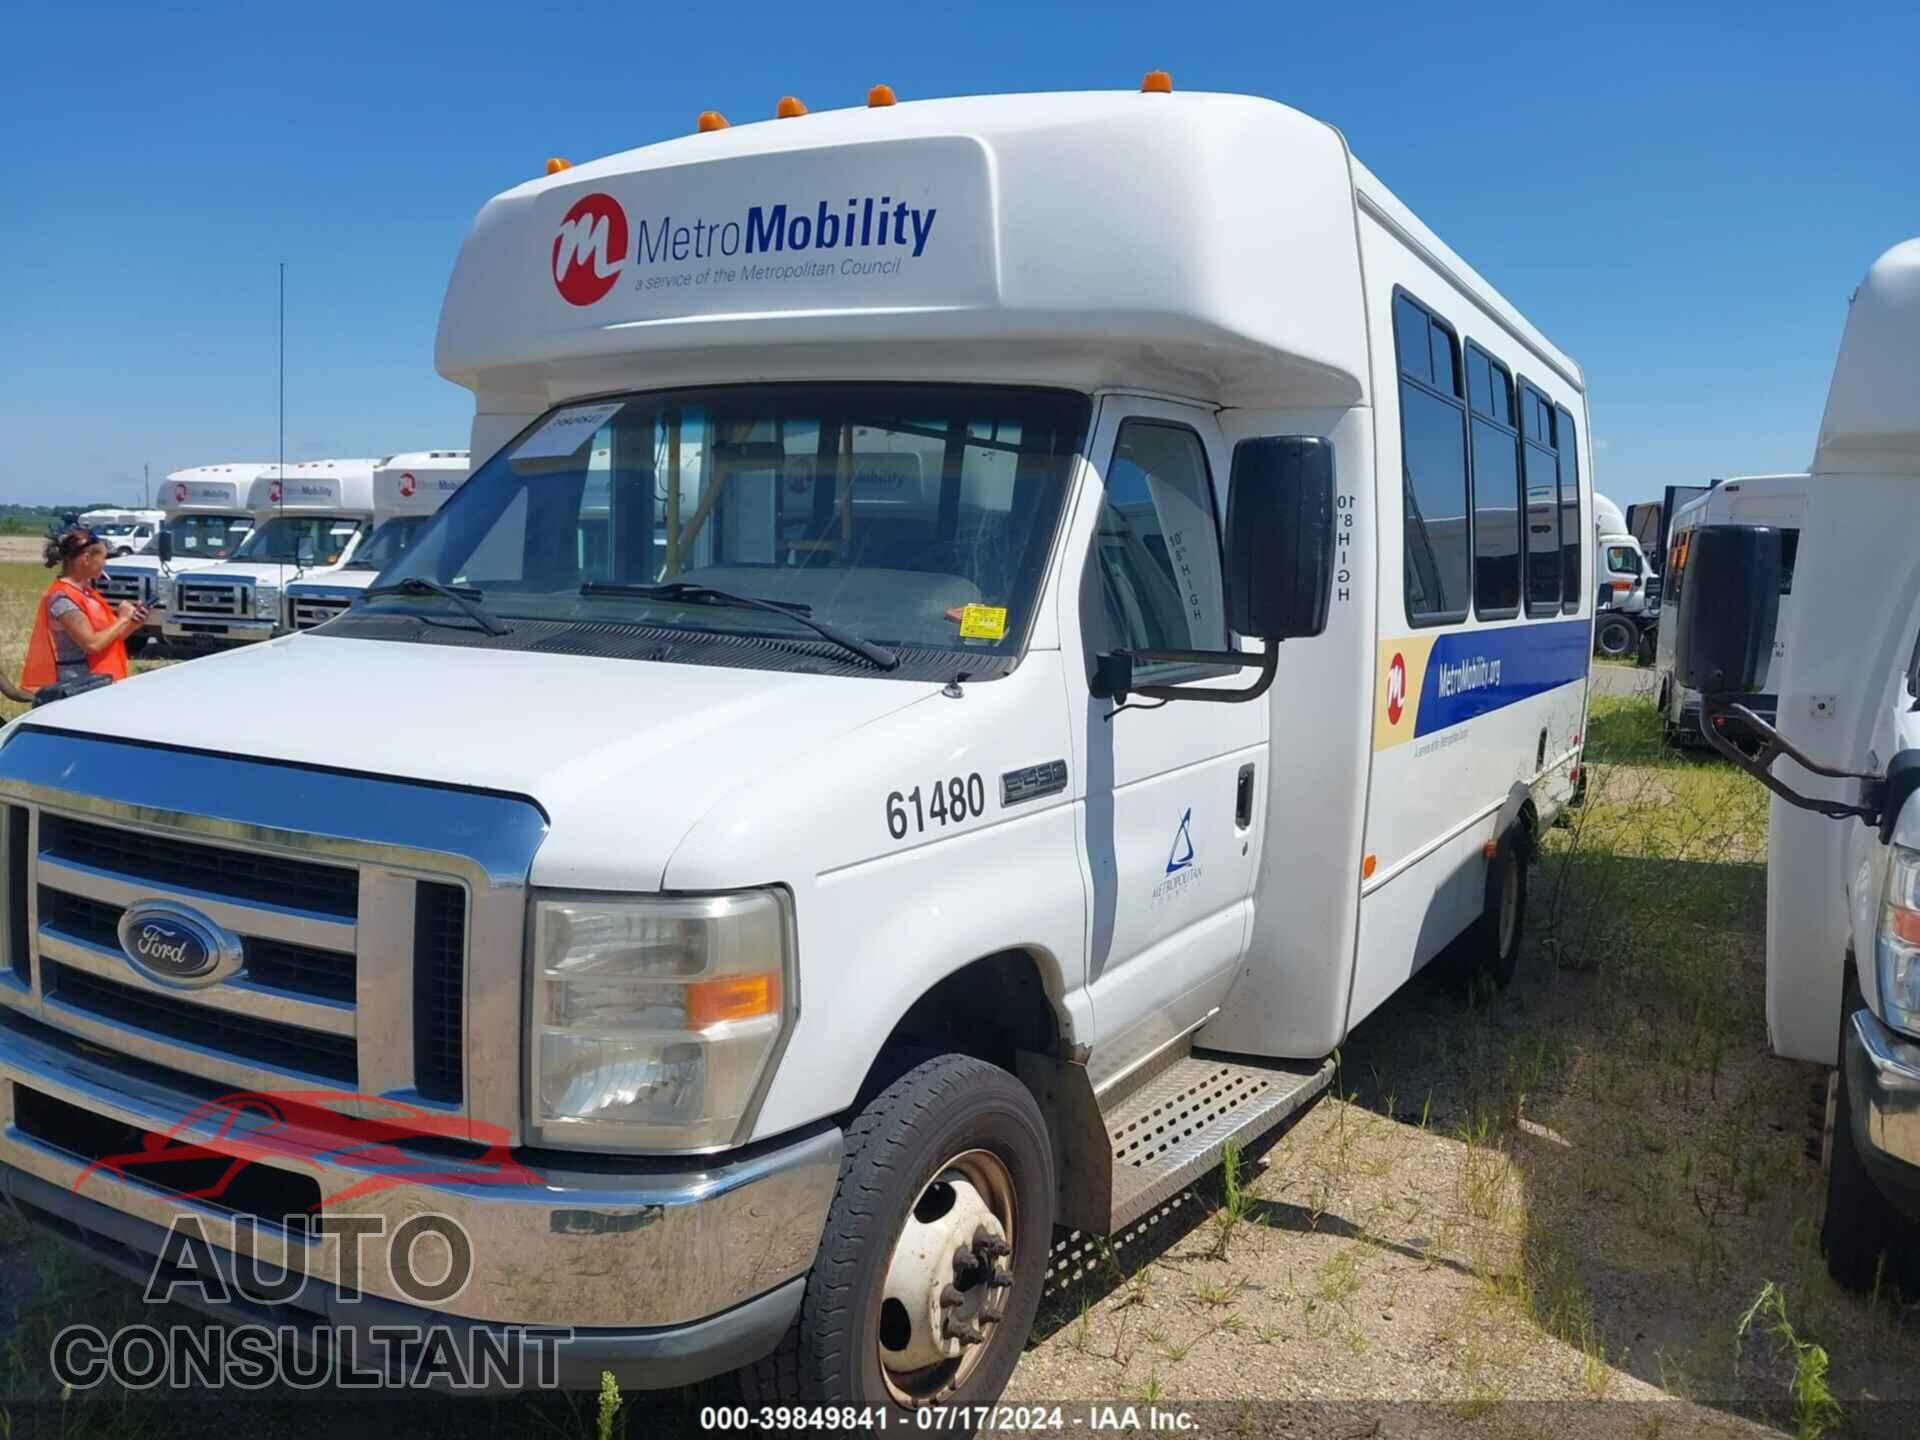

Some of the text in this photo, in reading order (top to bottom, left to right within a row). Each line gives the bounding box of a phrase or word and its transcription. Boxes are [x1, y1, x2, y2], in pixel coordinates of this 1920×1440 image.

[636, 195, 937, 266] MetroMobility
[634, 257, 901, 291] a service of the Metropolitan Council
[1438, 655, 1501, 698] MetroMobility.org
[886, 771, 985, 840] 61480
[137, 924, 187, 963] Ford
